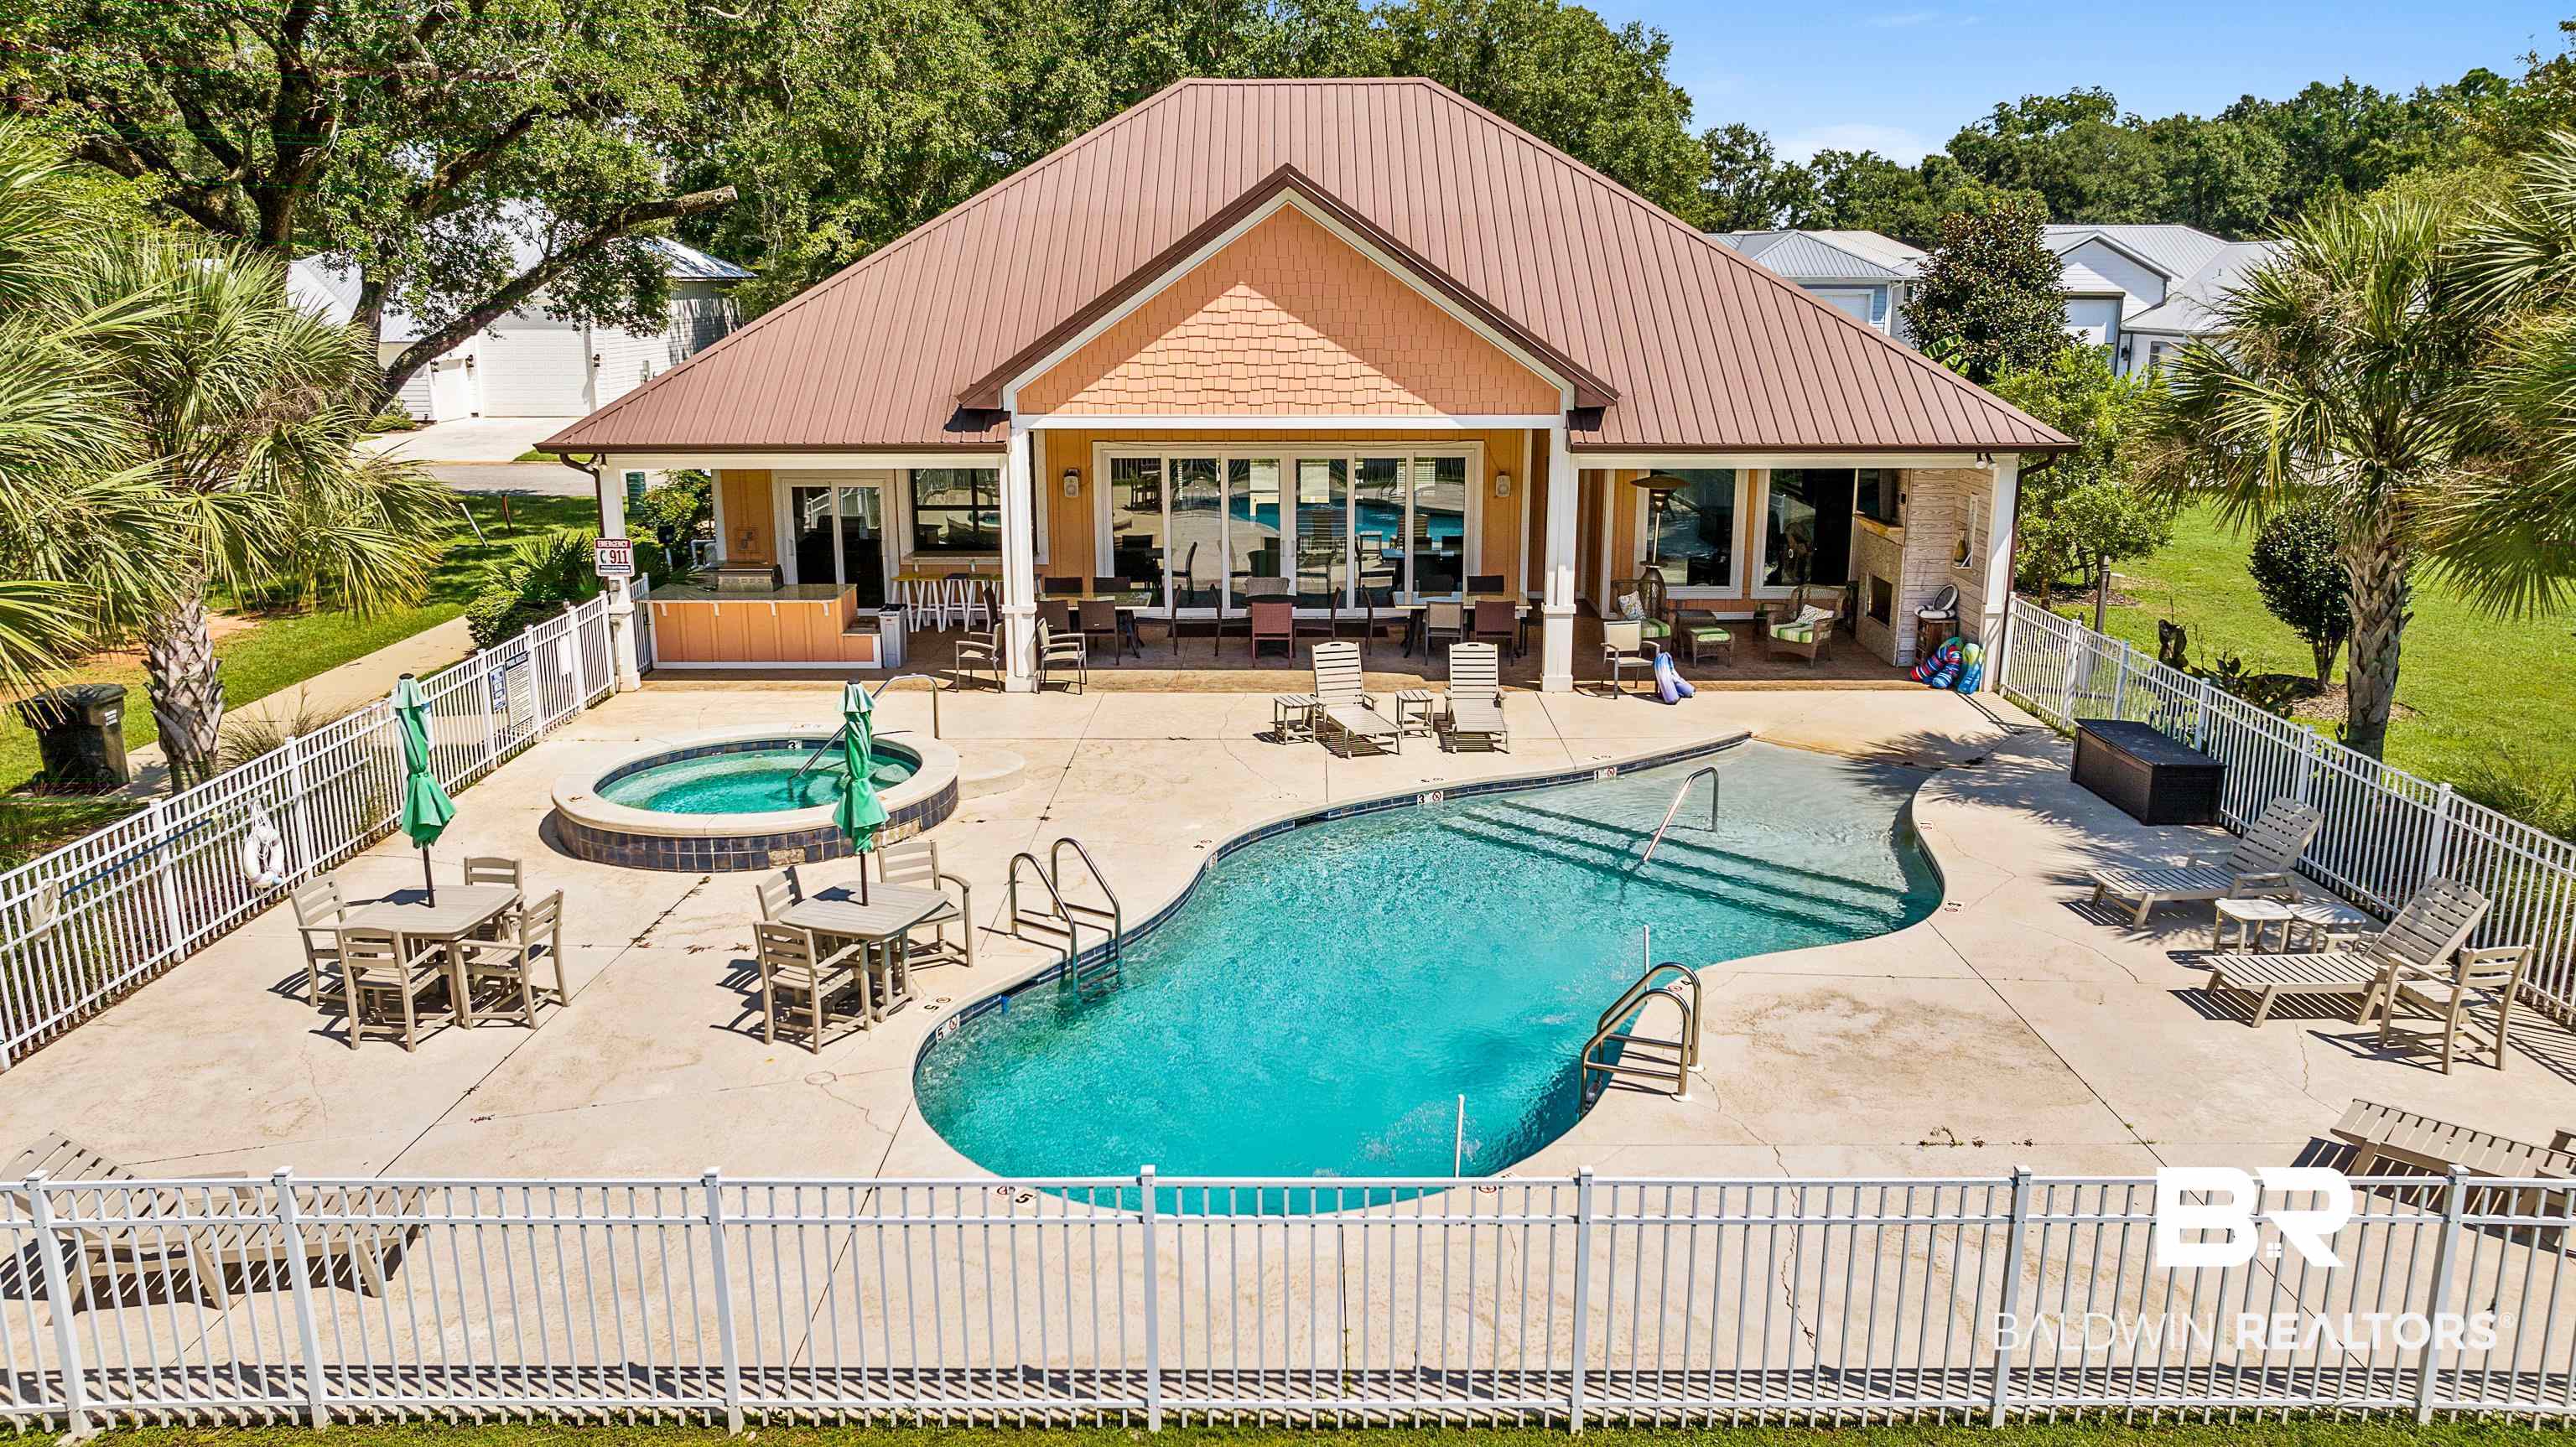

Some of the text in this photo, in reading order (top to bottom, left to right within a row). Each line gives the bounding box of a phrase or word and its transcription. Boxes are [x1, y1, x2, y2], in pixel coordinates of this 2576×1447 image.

[597, 540, 628, 548] EMERGENCY
[610, 549, 629, 563] 911
[1418, 794, 1426, 804] 3
